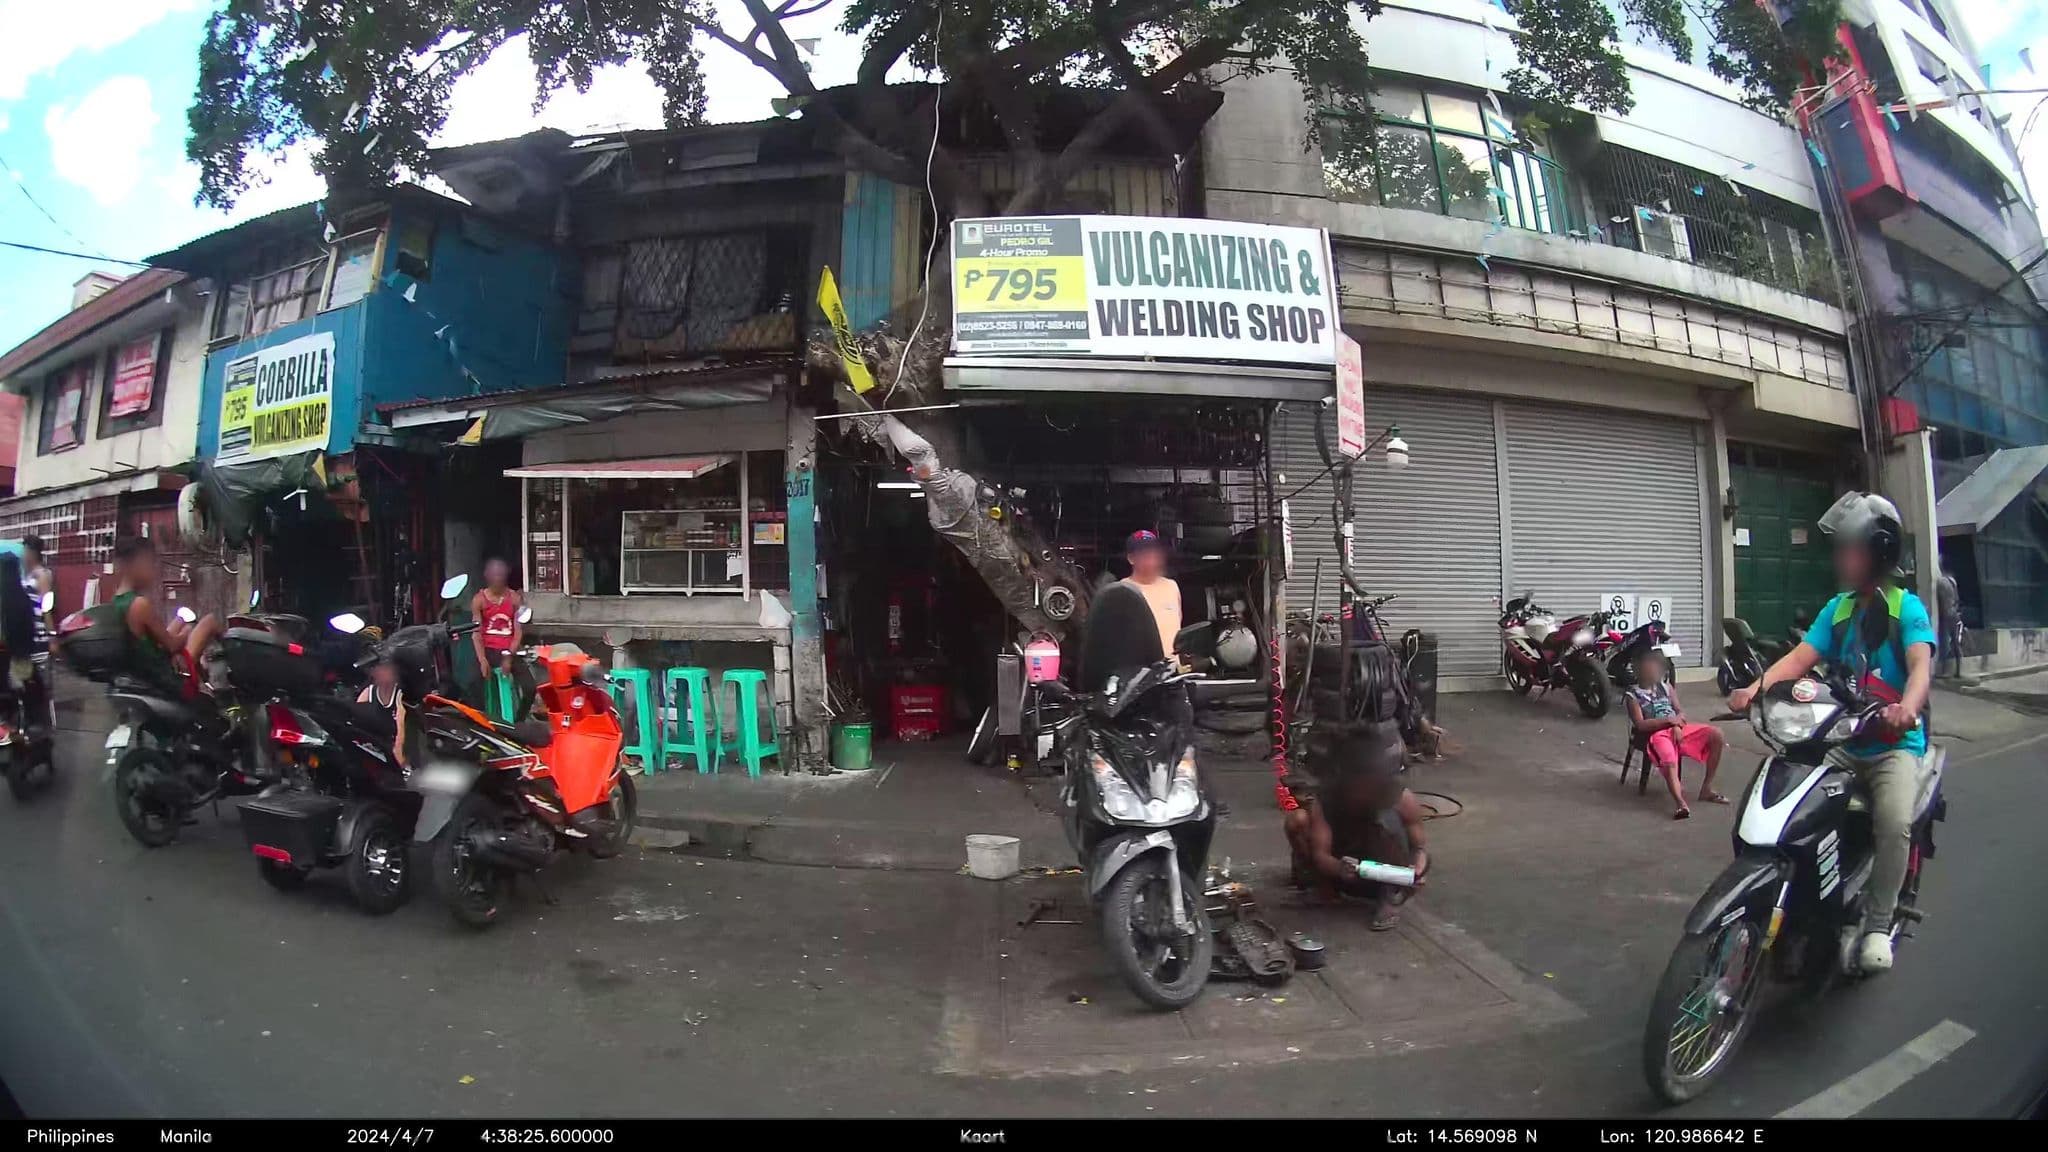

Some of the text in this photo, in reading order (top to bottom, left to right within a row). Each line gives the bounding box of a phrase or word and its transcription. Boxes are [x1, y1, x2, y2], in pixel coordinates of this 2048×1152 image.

[983, 223, 1053, 234] EUROTEL
[1000, 237, 1054, 247] PEDRO GIL
[980, 248, 1049, 257] 4-Hour Promo
[1088, 231, 1321, 296] VULCANIZING &
[1095, 299, 1326, 344] WELDING SHOP
[256, 348, 328, 407] CORBILLA
[303, 403, 327, 437] SHOP
